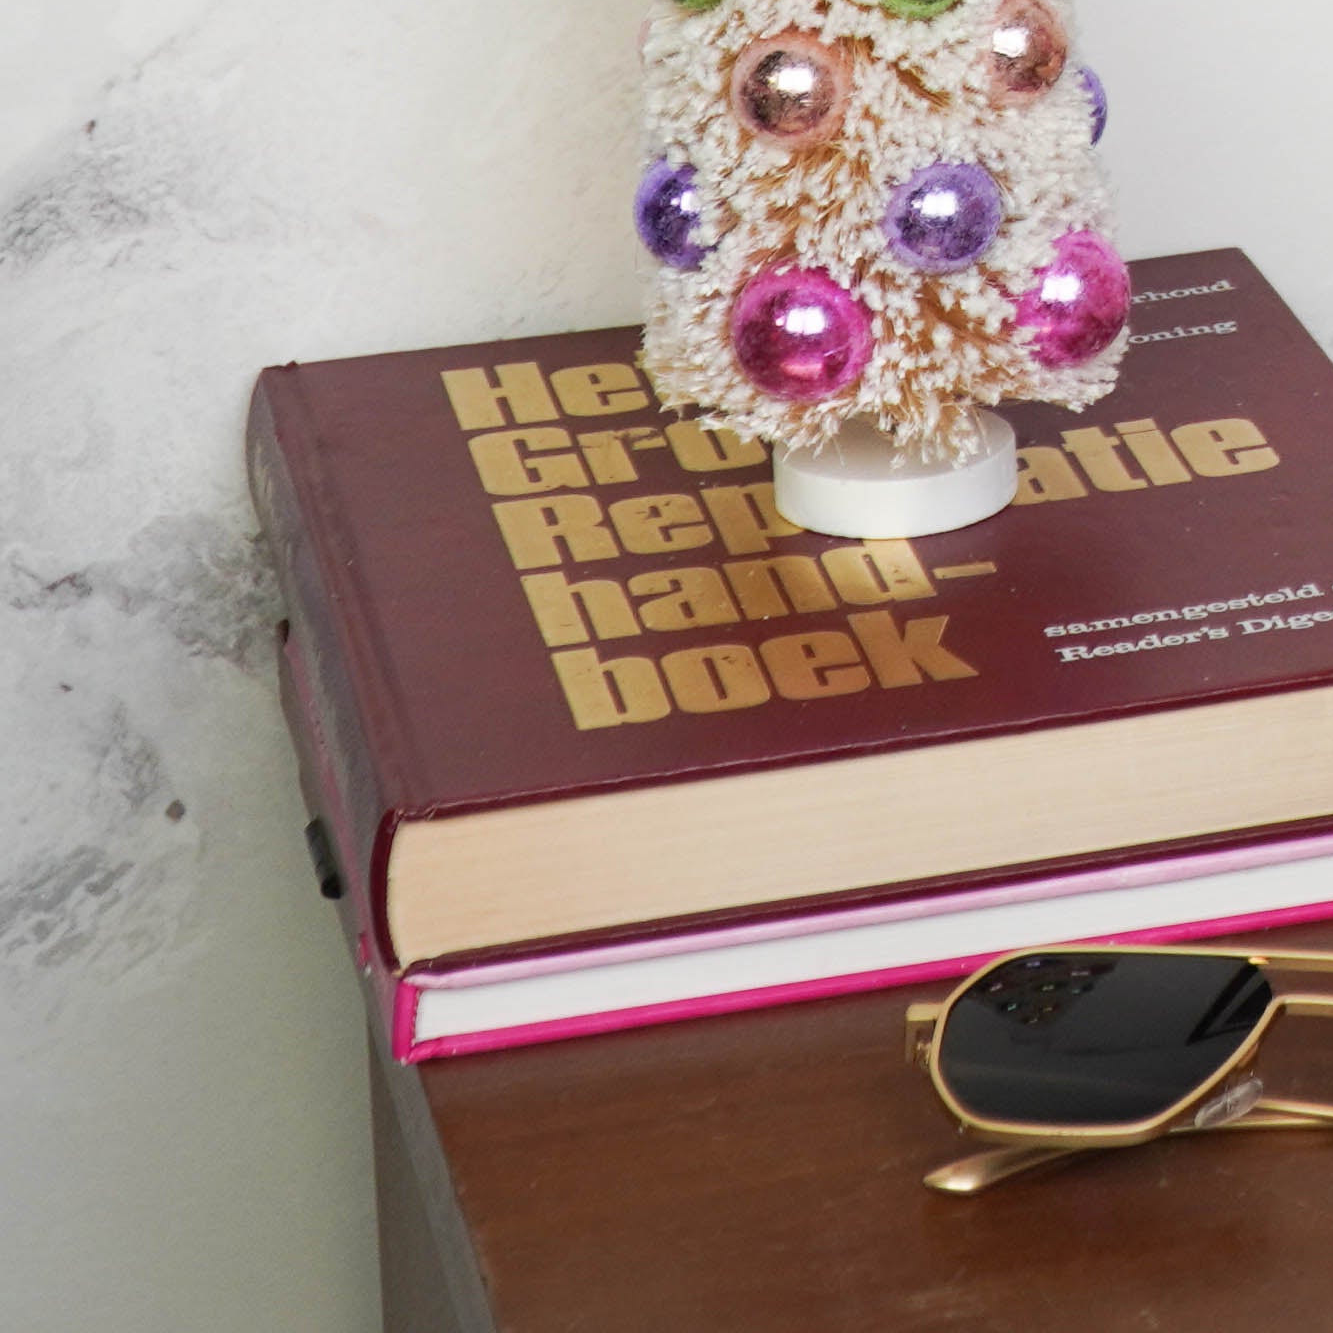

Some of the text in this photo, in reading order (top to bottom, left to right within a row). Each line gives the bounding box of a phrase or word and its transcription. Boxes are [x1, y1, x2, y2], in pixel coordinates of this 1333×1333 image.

[1131, 279, 1236, 305] rhoud
[1128, 321, 1238, 344] oning
[467, 419, 769, 496] Gro
[491, 417, 1280, 570] Repatie
[520, 537, 997, 648] hand-
[1043, 583, 1325, 637] samengesteld
[551, 609, 981, 731] boek
[1055, 625, 1230, 663] Reader's
